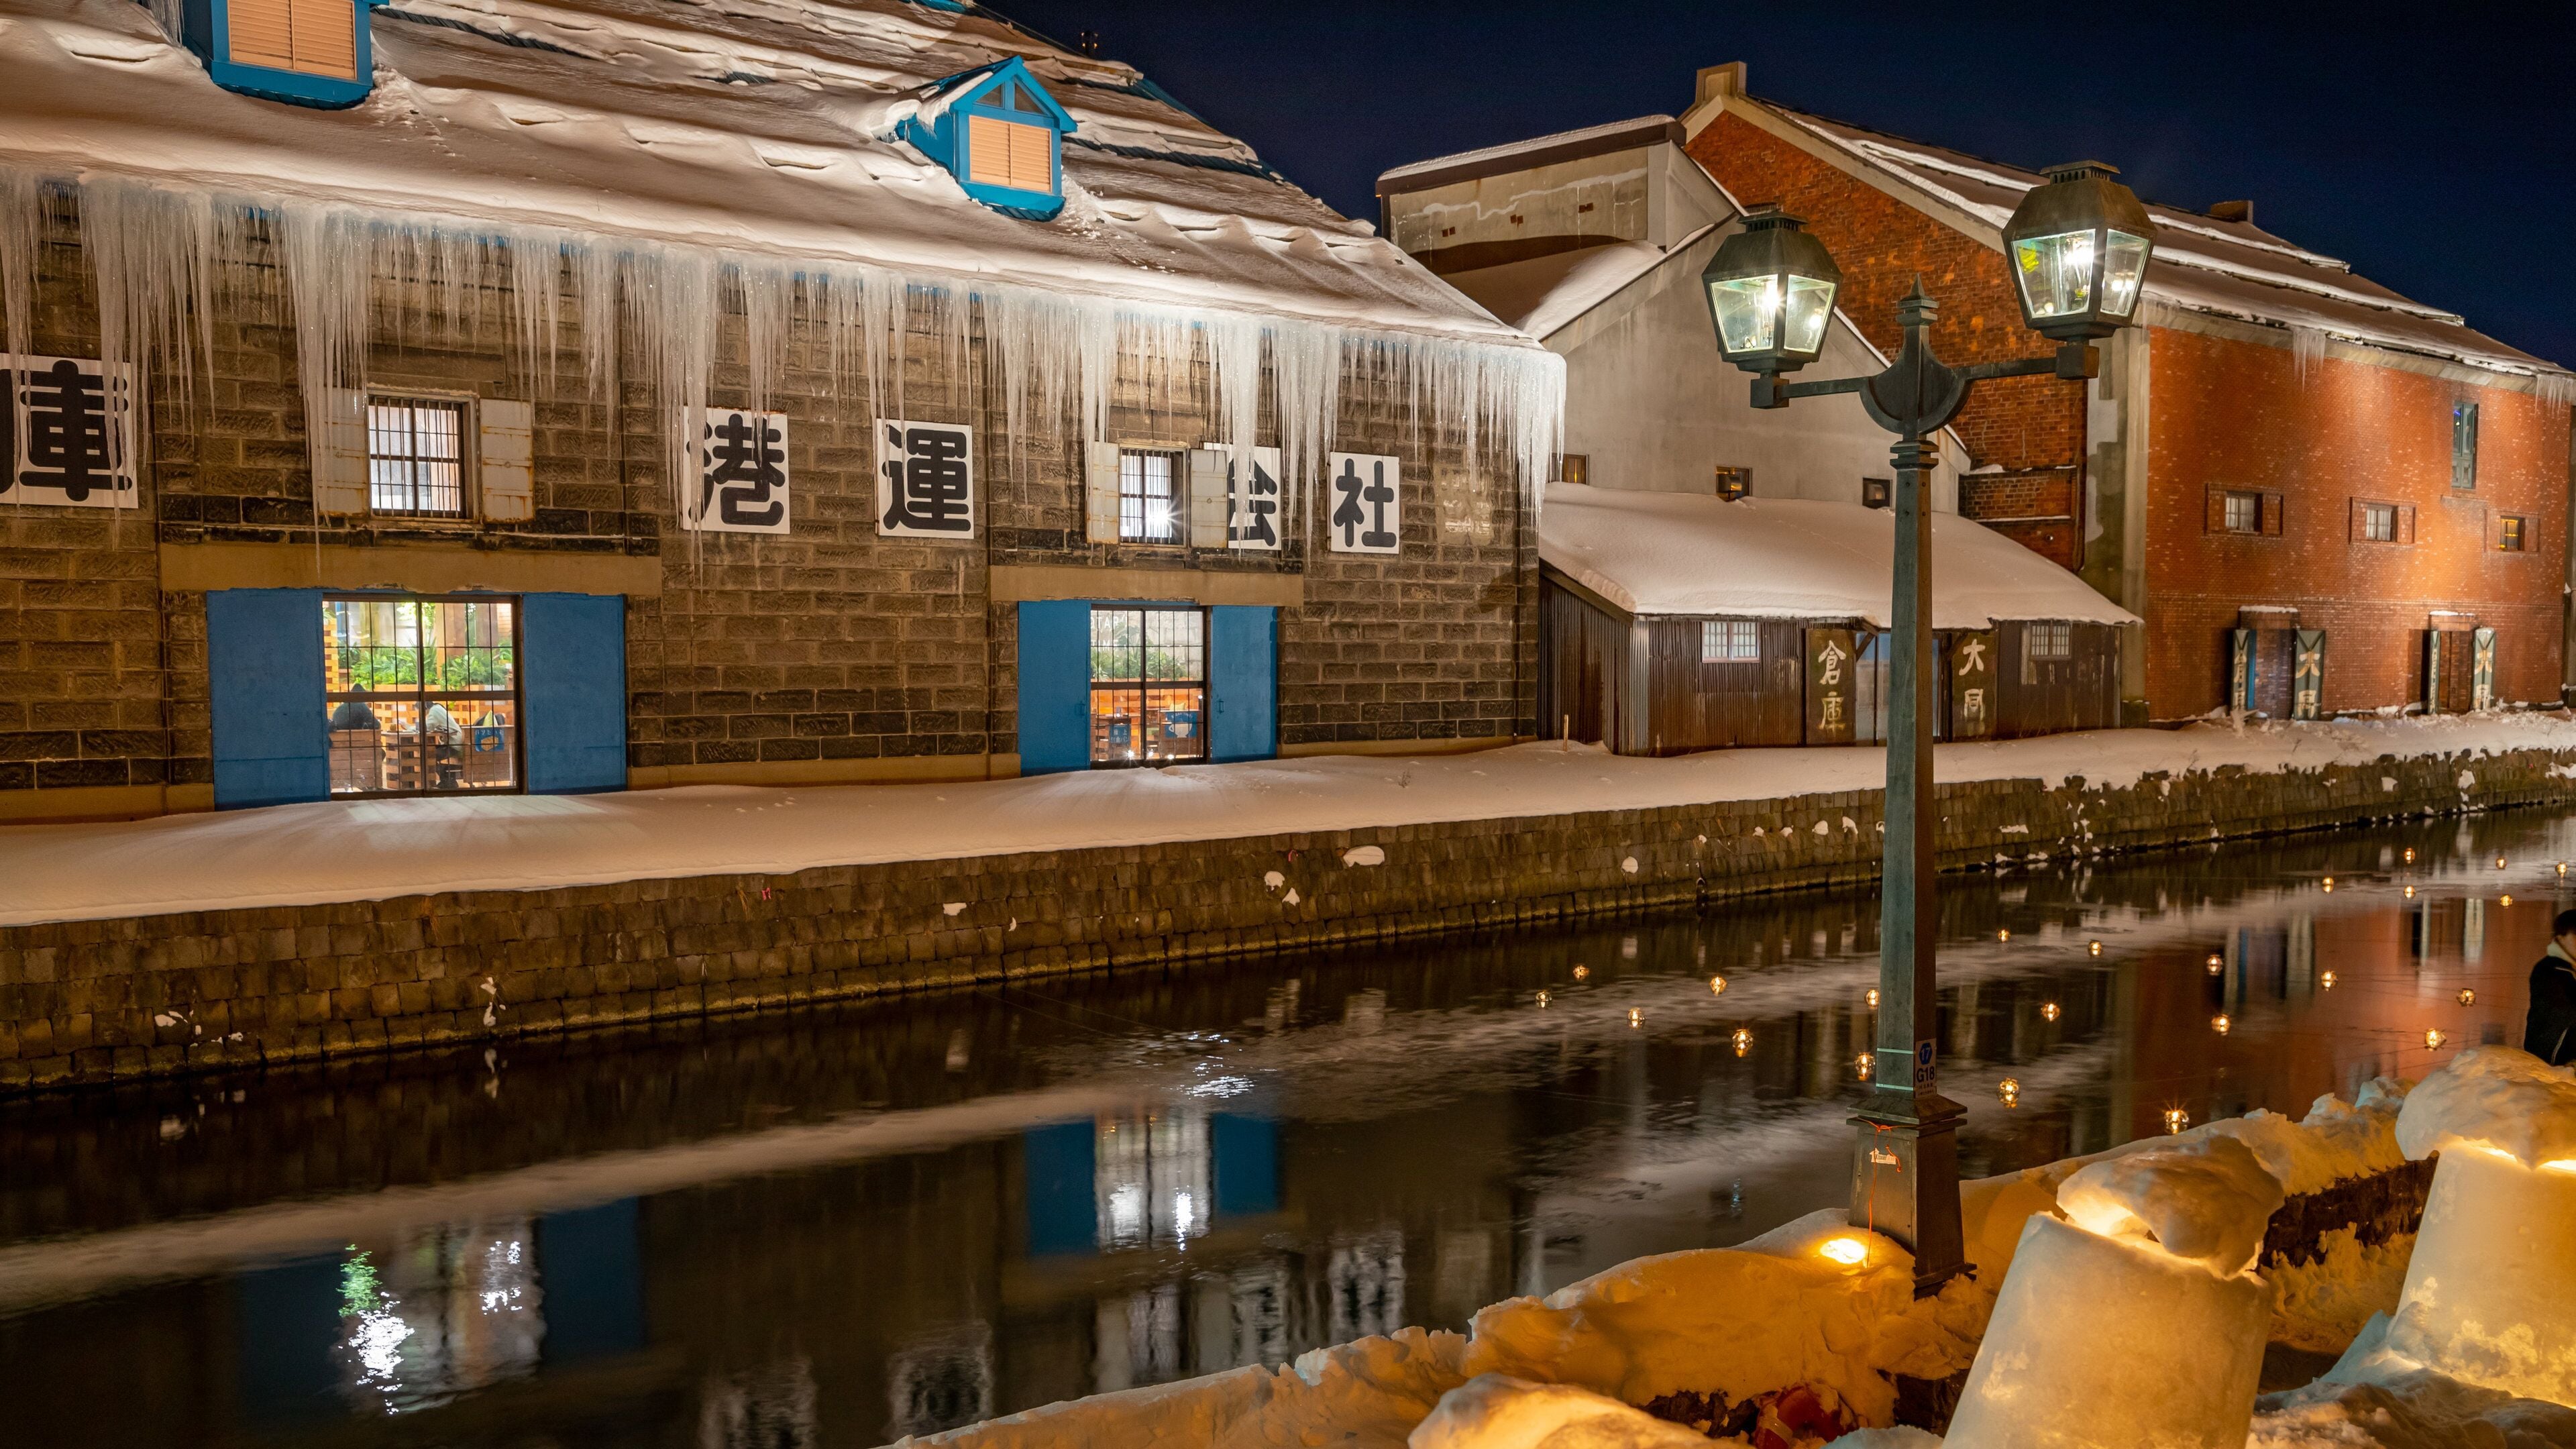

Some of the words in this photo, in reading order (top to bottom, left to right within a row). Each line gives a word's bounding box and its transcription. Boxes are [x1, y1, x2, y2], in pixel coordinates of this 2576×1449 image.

[0, 360, 133, 502] 庫
[686, 413, 786, 526] 港
[881, 423, 971, 531] 運
[1333, 458, 1397, 547] 社
[1818, 639, 1846, 736] 倉庫
[1917, 1066, 1935, 1083] G18
[1919, 1046, 1931, 1061] 17
